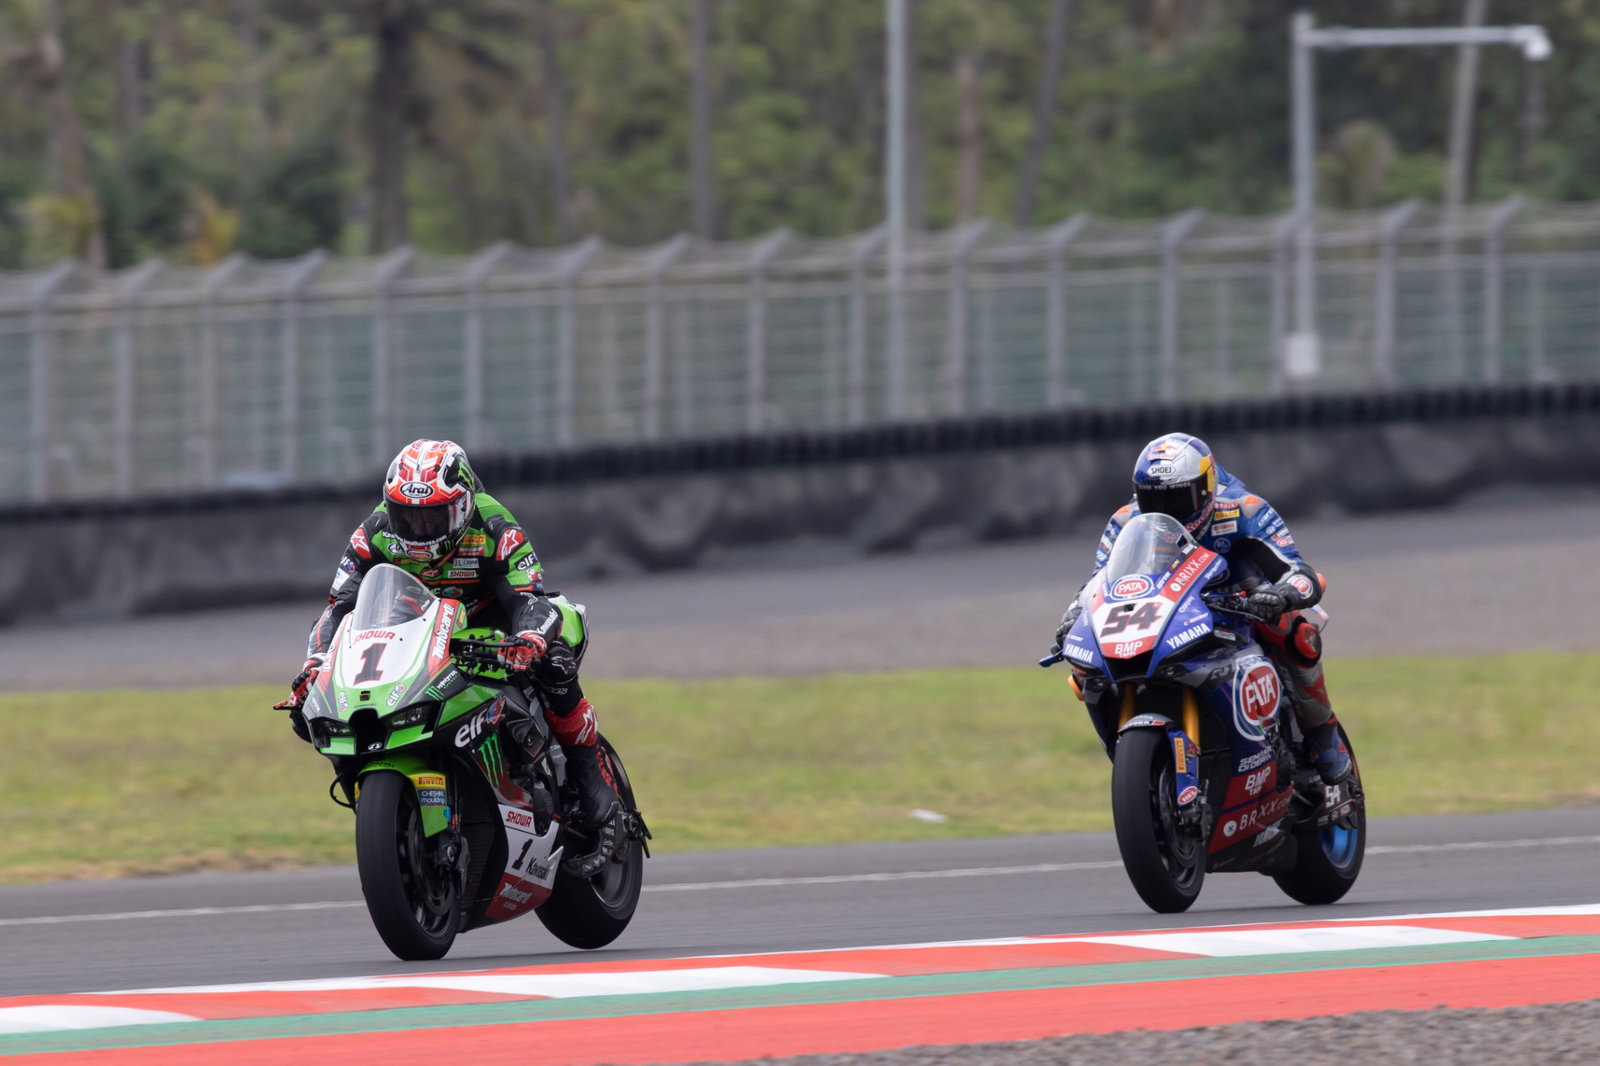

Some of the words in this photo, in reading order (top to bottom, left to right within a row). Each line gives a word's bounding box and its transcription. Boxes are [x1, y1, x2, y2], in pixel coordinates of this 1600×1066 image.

[402, 484, 429, 495] Arai
[518, 553, 534, 571] elf
[1118, 582, 1143, 593] PATA
[1100, 602, 1163, 638] 54
[1166, 623, 1211, 649] YAMAHA
[1064, 643, 1094, 663] YAMAHA
[1115, 641, 1143, 655] BMP
[353, 643, 387, 686] 1
[387, 690, 400, 706] elf
[1245, 673, 1276, 713] PATA
[455, 708, 488, 748] elf
[418, 777, 444, 785] PIRELLI
[1245, 766, 1271, 790] BMP
[1325, 785, 1341, 807] 54
[505, 810, 533, 828] SHOWA
[511, 838, 534, 870] 1
